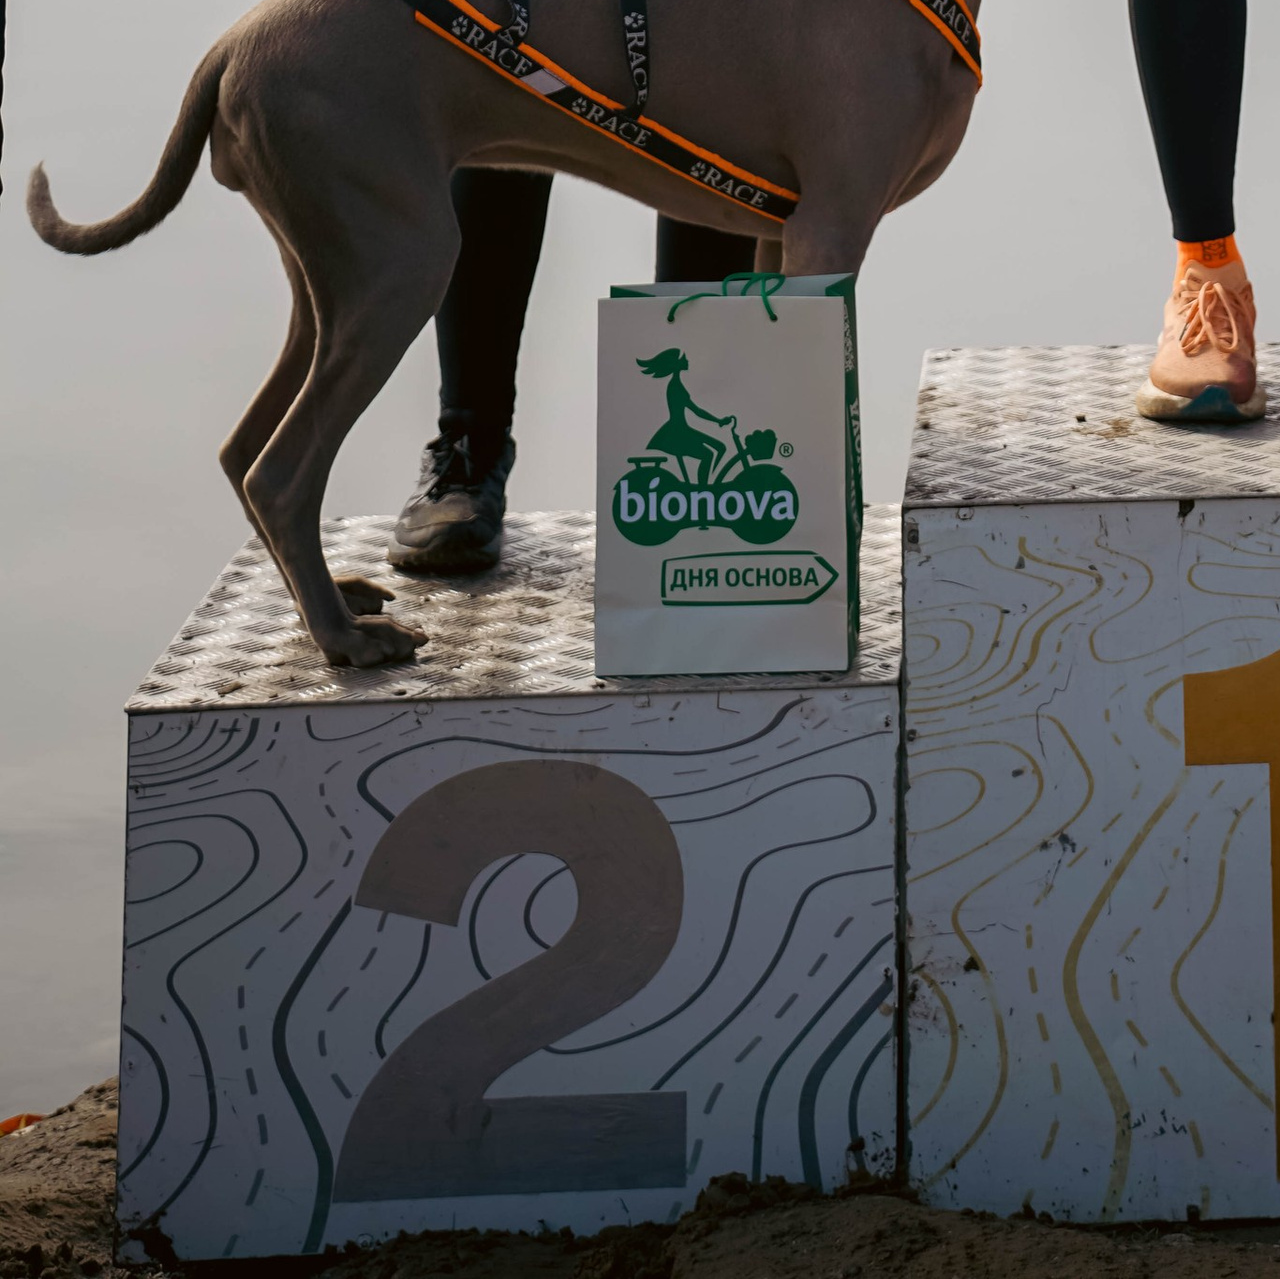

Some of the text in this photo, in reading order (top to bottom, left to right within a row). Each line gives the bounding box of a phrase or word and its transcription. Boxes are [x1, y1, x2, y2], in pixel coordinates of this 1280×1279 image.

[465, 24, 533, 78] RACE
[626, 29, 648, 105] RACE
[585, 102, 652, 148] RACE
[703, 166, 769, 208] RACE
[619, 475, 796, 523] bionova
[670, 567, 820, 592] ДНЯ ОСНОВА
[333, 759, 686, 1205] 2
